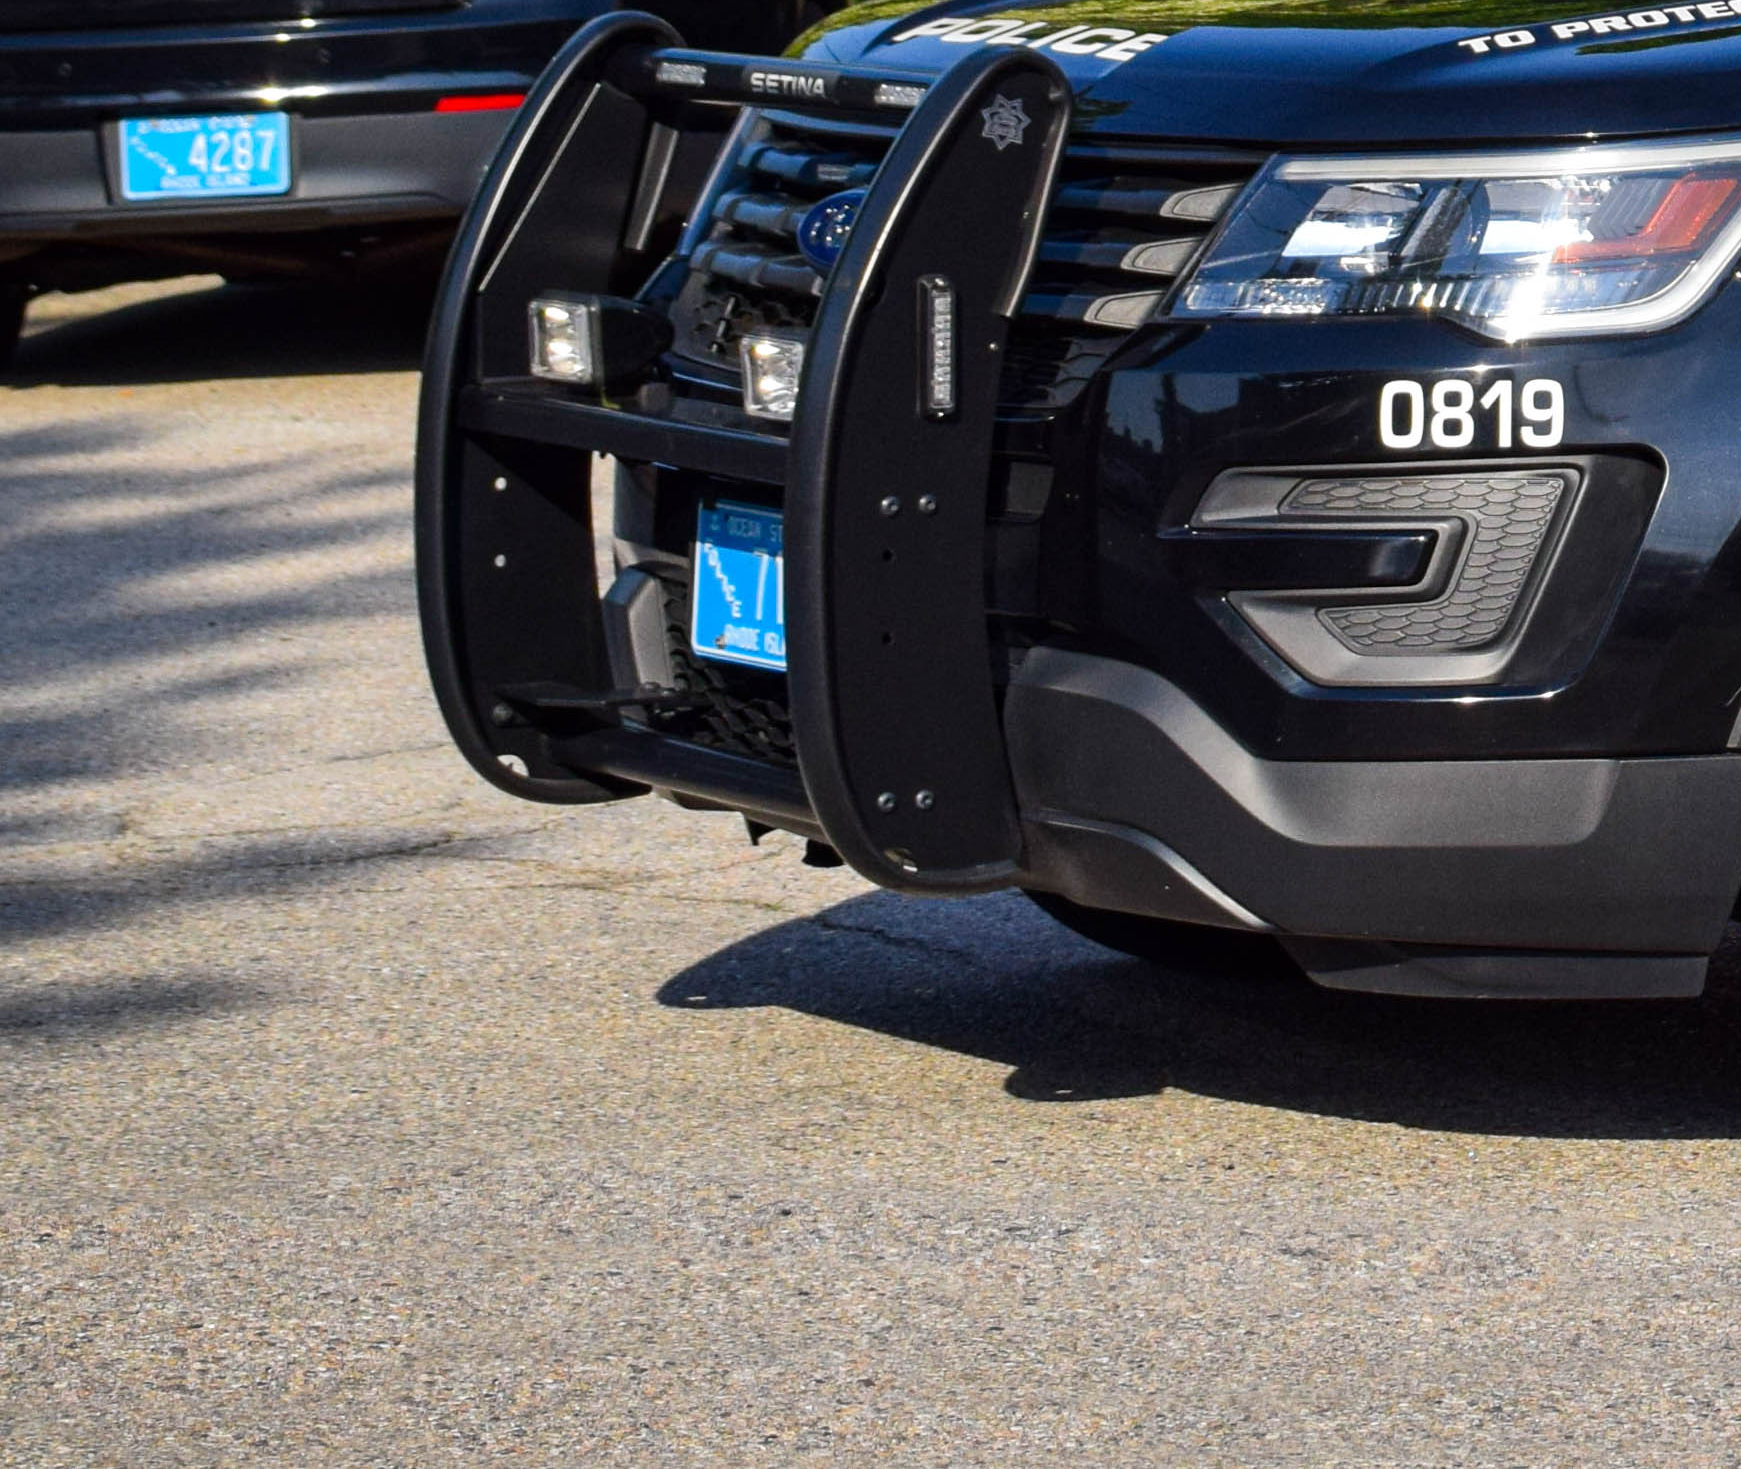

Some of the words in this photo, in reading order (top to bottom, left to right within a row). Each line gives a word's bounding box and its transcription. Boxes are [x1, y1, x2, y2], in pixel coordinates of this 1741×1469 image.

[891, 17, 1170, 62] POLICE
[1458, 29, 1537, 54] TO
[751, 71, 826, 98] SETINA
[188, 131, 276, 173] 4287
[1378, 379, 1565, 450] 0819
